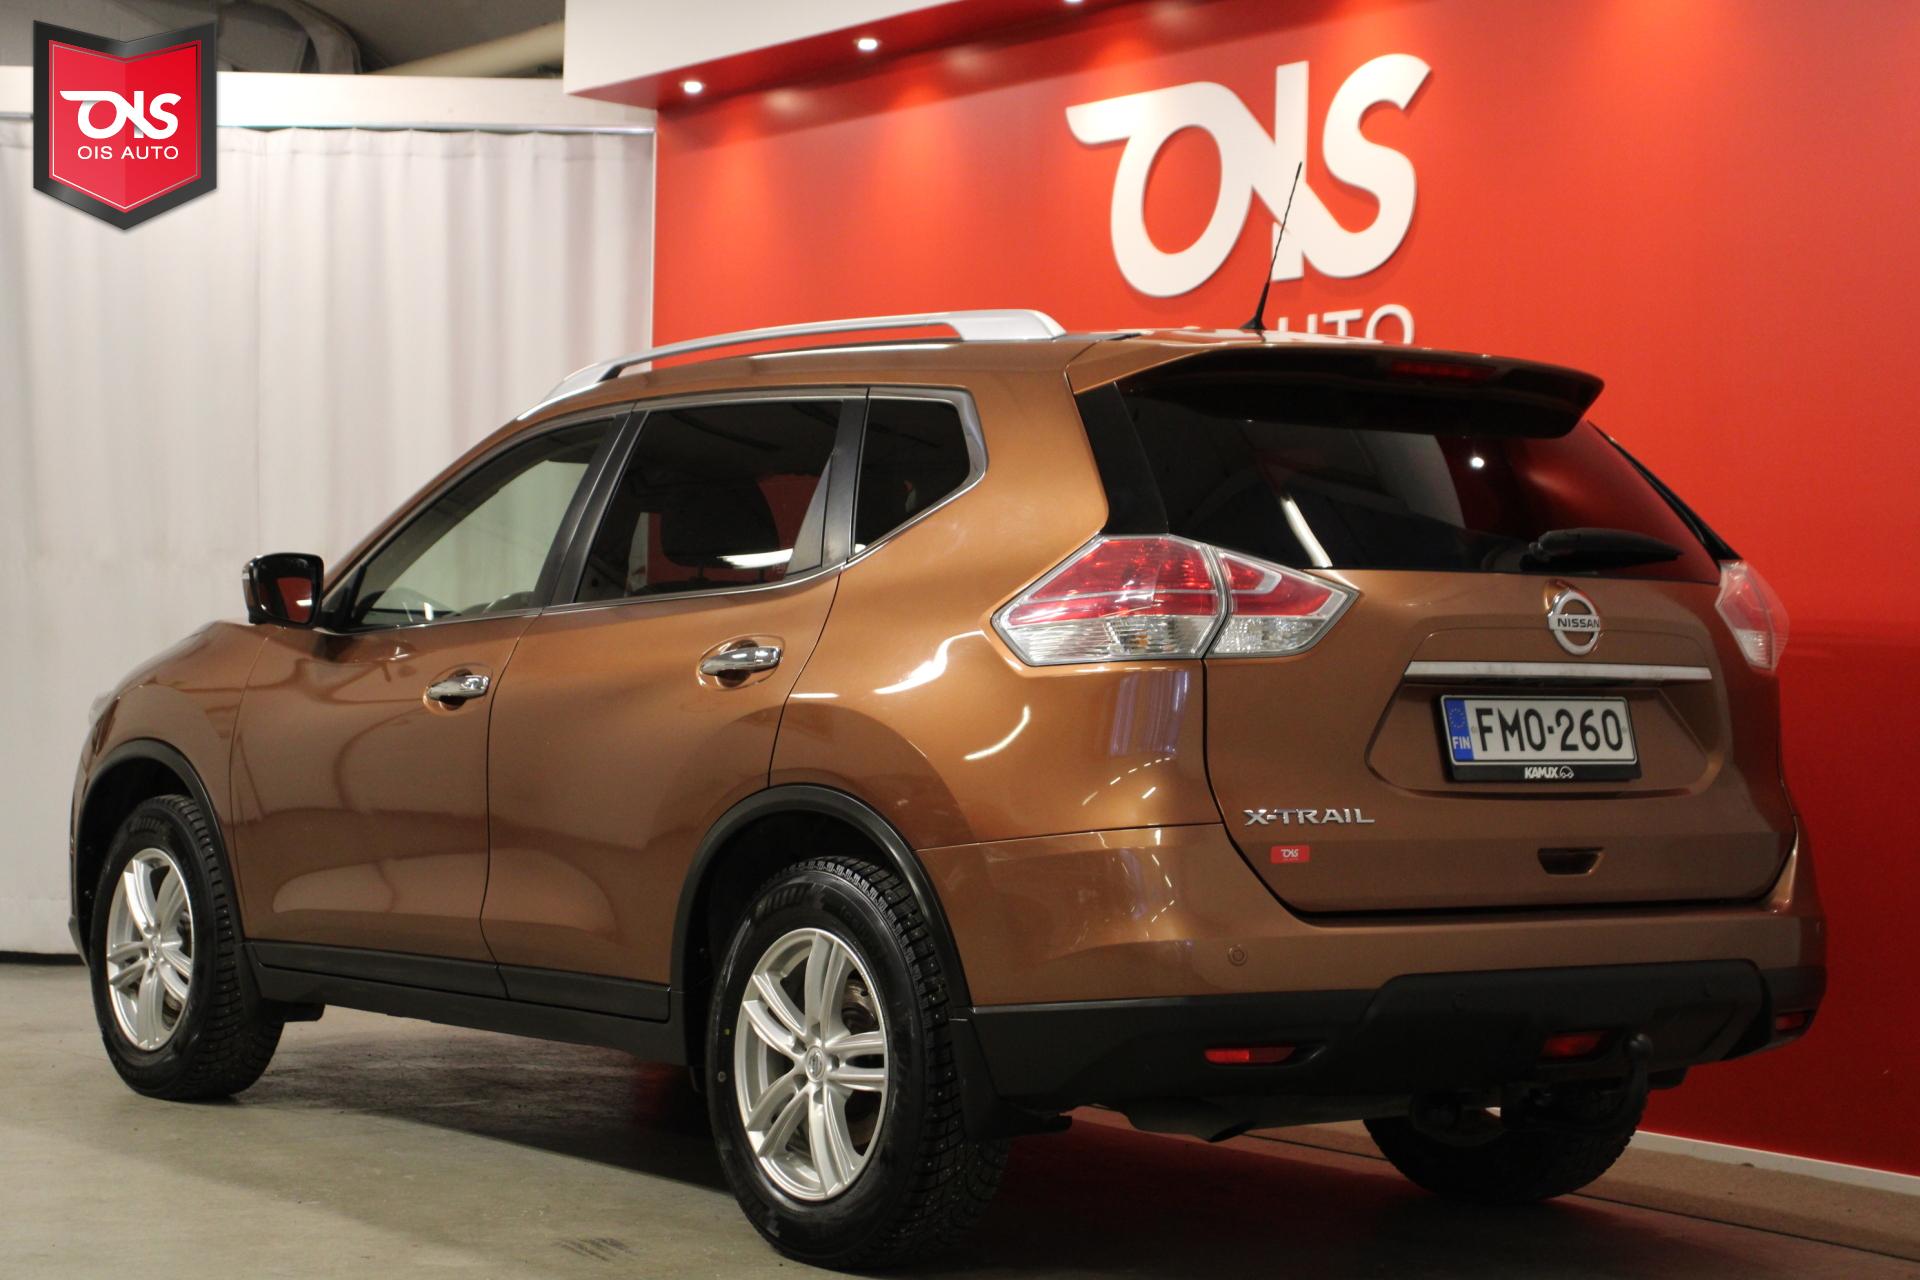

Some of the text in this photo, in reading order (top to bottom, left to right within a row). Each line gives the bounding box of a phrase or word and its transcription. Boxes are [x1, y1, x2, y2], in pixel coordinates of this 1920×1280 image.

[1556, 617, 1600, 629] NISSAN
[1453, 735, 1472, 750] FIN
[1524, 766, 1559, 779] KAMUX
[1242, 808, 1376, 826] X-TRAIL
